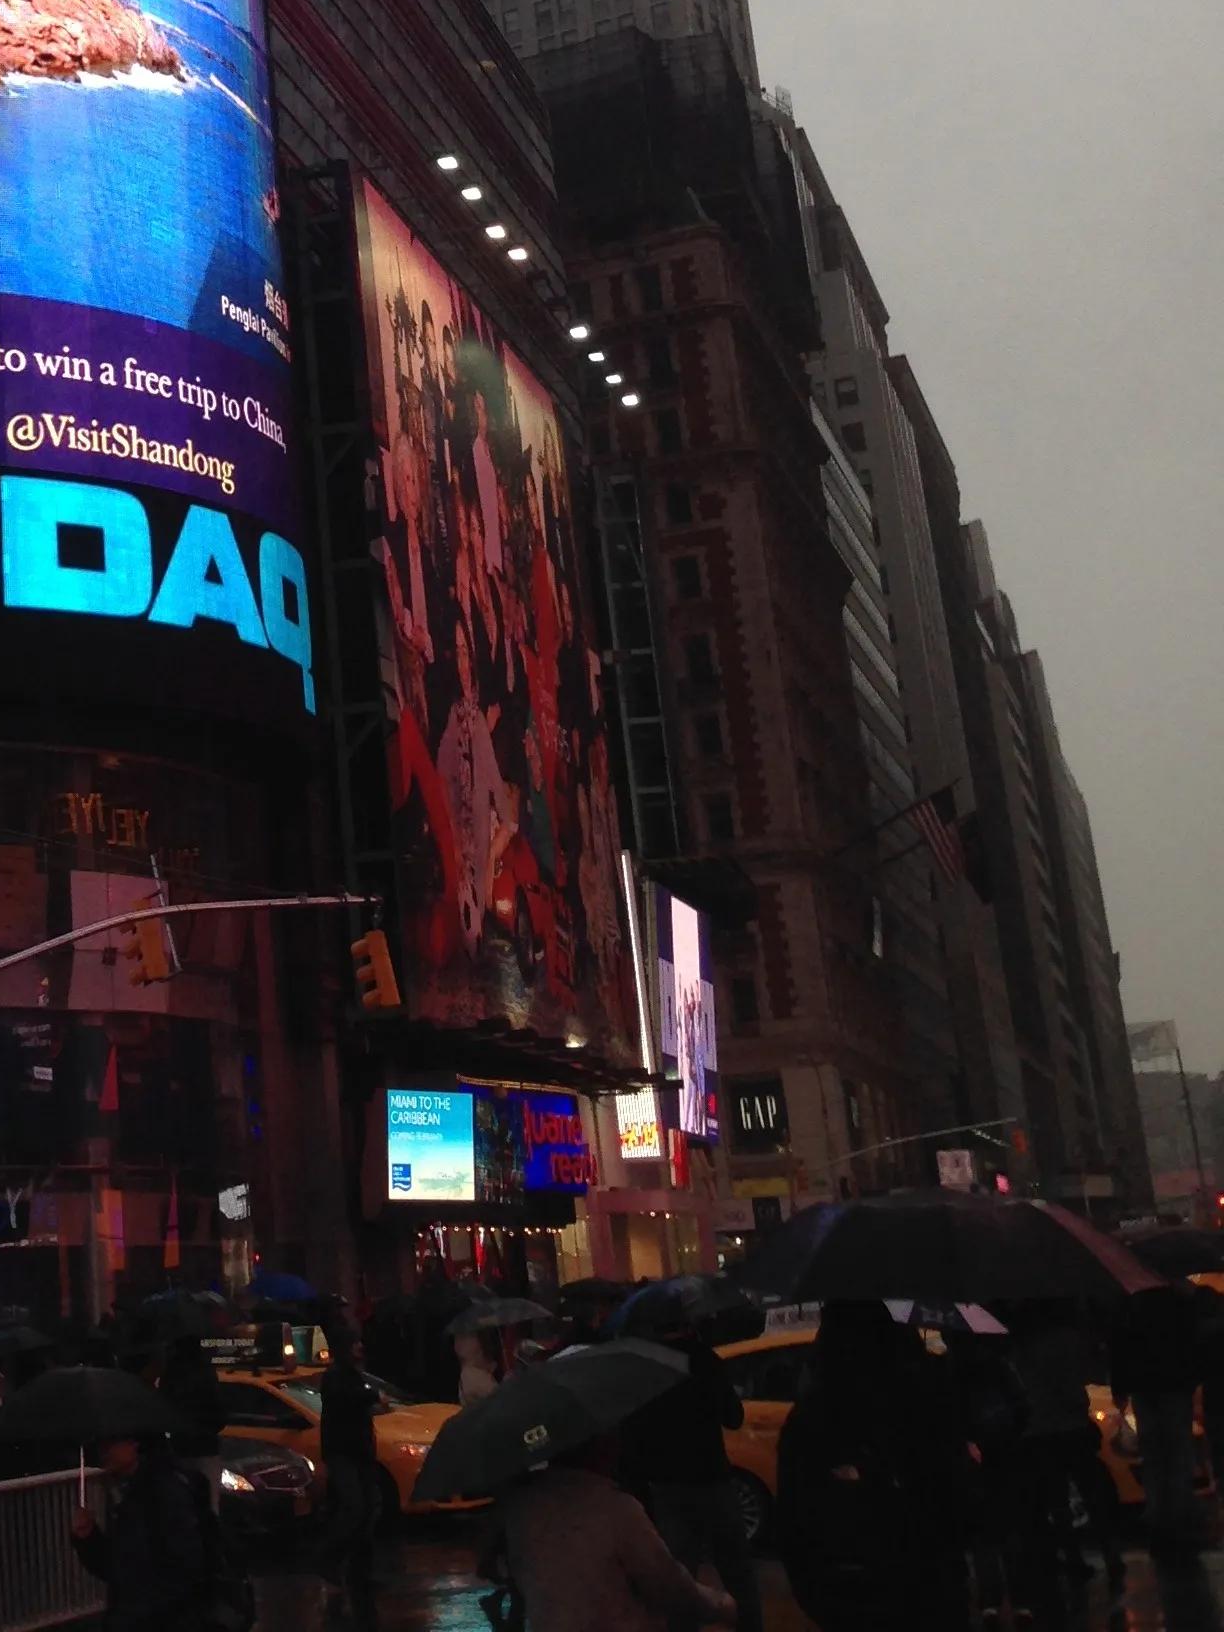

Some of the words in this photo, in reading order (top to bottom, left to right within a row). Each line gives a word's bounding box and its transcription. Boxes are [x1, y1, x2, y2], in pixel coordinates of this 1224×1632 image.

[33, 345, 93, 382] win
[99, 360, 117, 387] a
[123, 357, 173, 398] free
[177, 375, 218, 420] trip
[221, 391, 240, 421] to
[6, 412, 236, 495] @VisitShandong
[390, 1095, 417, 1110] MIAMI
[419, 1095, 432, 1110] TO
[434, 1097, 451, 1111] THE
[390, 1111, 441, 1126] CARIBBEAN
[739, 1094, 777, 1131] GAP
